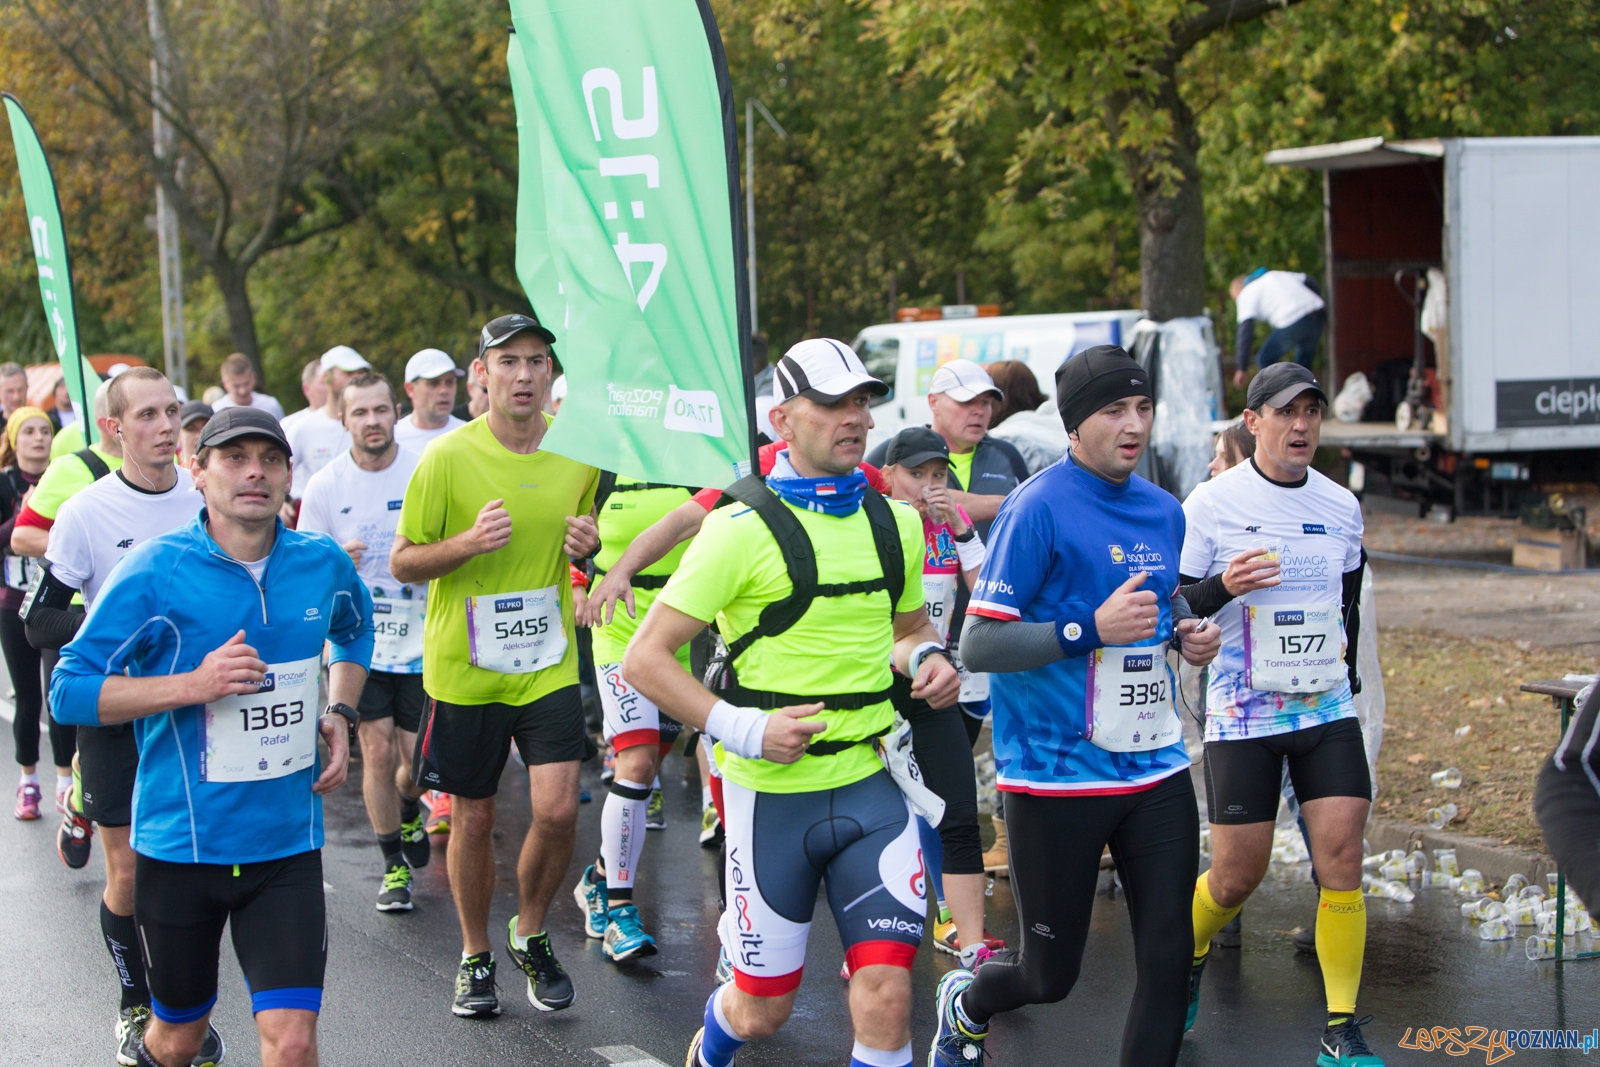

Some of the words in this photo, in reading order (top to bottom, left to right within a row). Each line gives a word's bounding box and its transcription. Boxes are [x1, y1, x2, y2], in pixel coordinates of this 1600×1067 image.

[117, 539, 134, 549] 4F
[1281, 566, 1328, 578] YBKOŚĆ
[497, 601, 521, 610] 17.PKO
[1277, 614, 1302, 622] 17.PKO
[375, 621, 409, 637] 458
[495, 616, 548, 639] 5455
[502, 639, 545, 651] Aleksander
[1278, 634, 1326, 654] 1577
[1127, 658, 1151, 668] 17.PKO
[1264, 659, 1301, 668] Tomasz
[1302, 657, 1337, 667] Szczepan
[1120, 680, 1166, 706] 3392
[240, 700, 304, 732] 1363
[1137, 711, 1157, 720] Artur
[260, 733, 290, 747] Rafał
[282, 757, 293, 766] 4F
[1328, 903, 1357, 911] ROYAL
[867, 916, 924, 938] velocit
